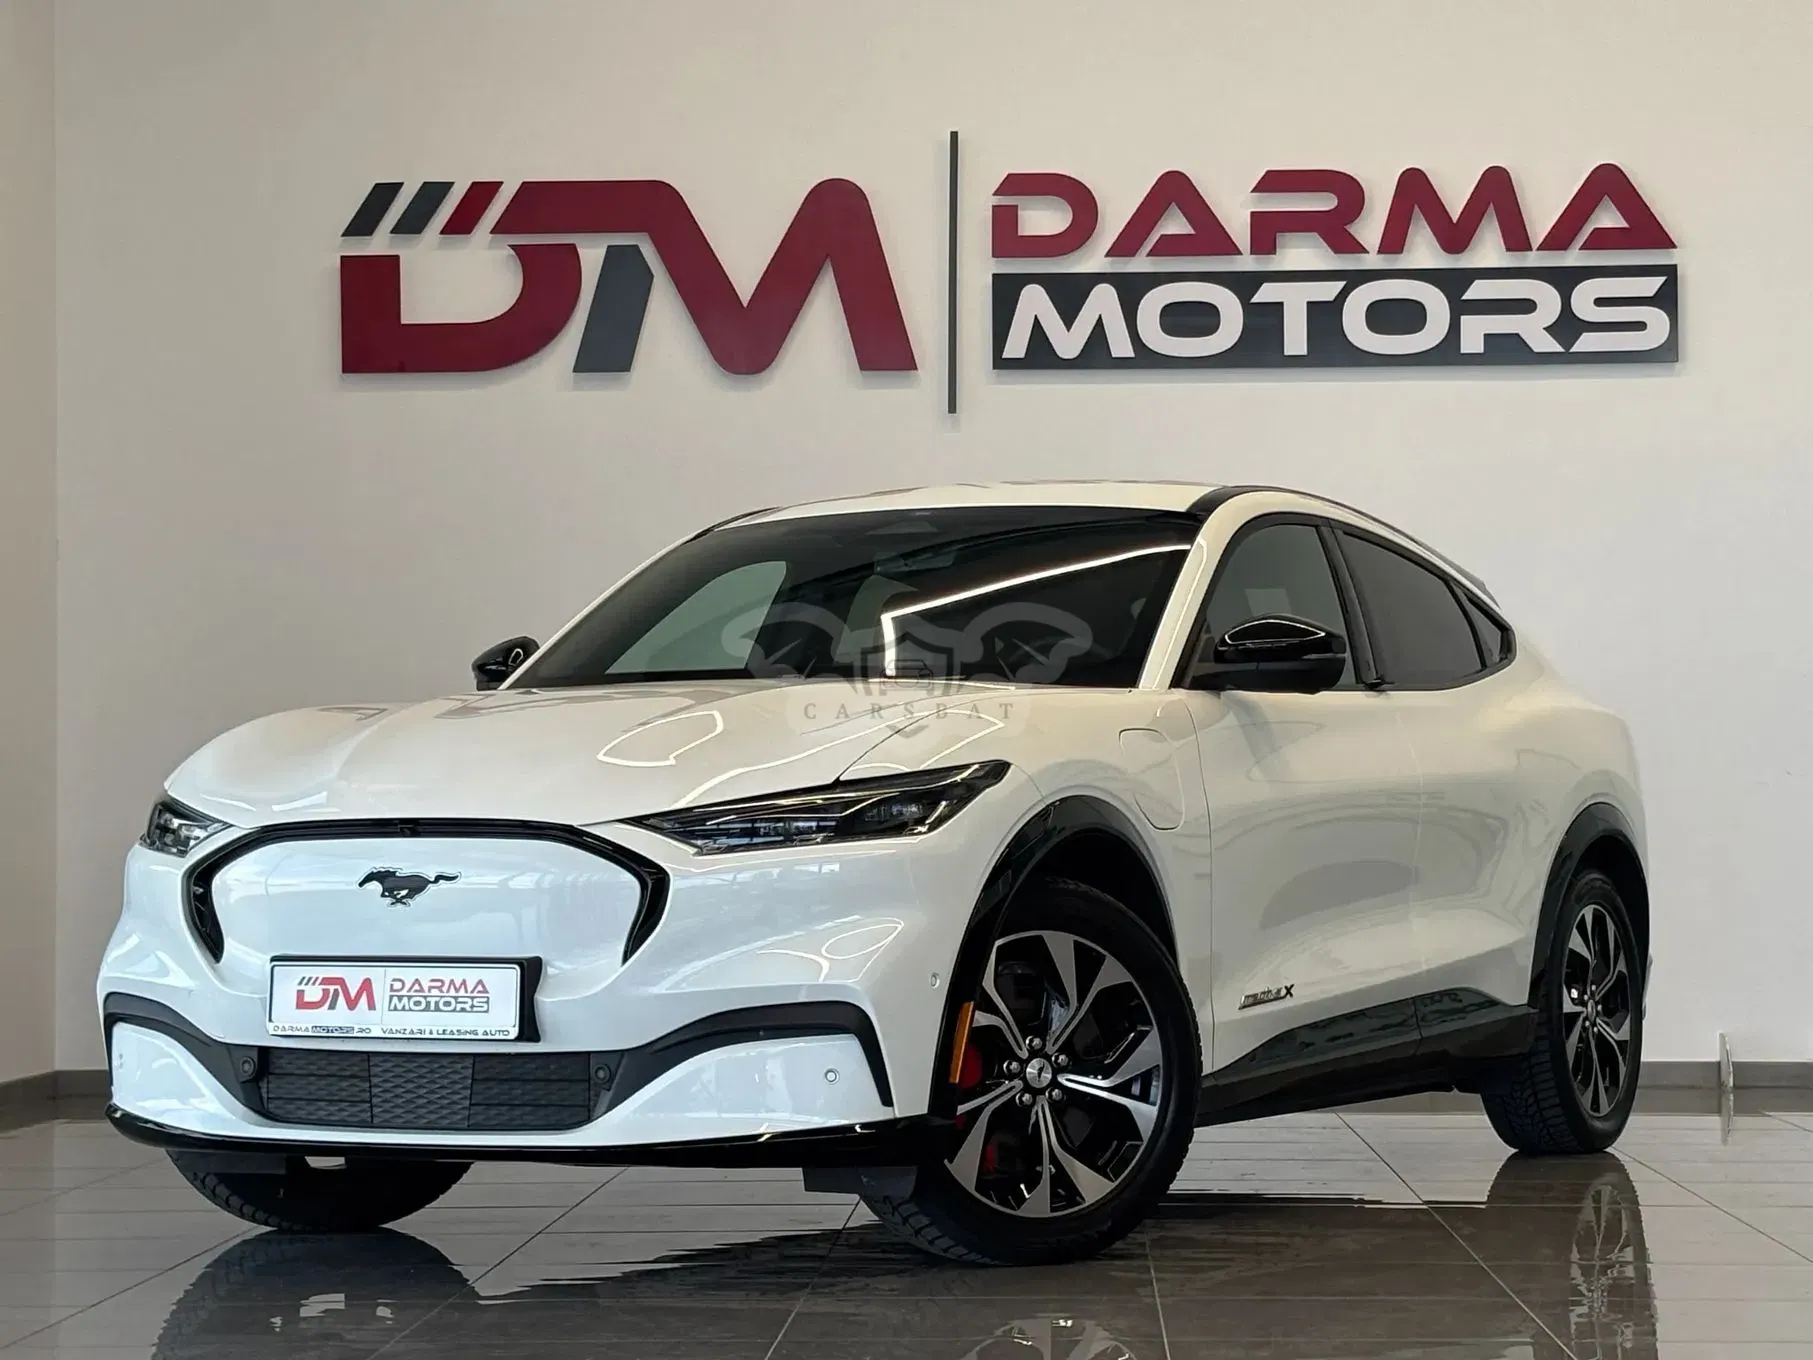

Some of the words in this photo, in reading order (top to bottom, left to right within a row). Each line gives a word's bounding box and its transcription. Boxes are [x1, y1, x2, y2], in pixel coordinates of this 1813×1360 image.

[991, 163, 1678, 258] DARMA
[1001, 276, 1671, 360] MOTORS
[389, 978, 490, 994] DARMA
[389, 996, 489, 1012] MOTORS
[436, 1028, 480, 1037] LEASING
[481, 1029, 511, 1037] AUTO
